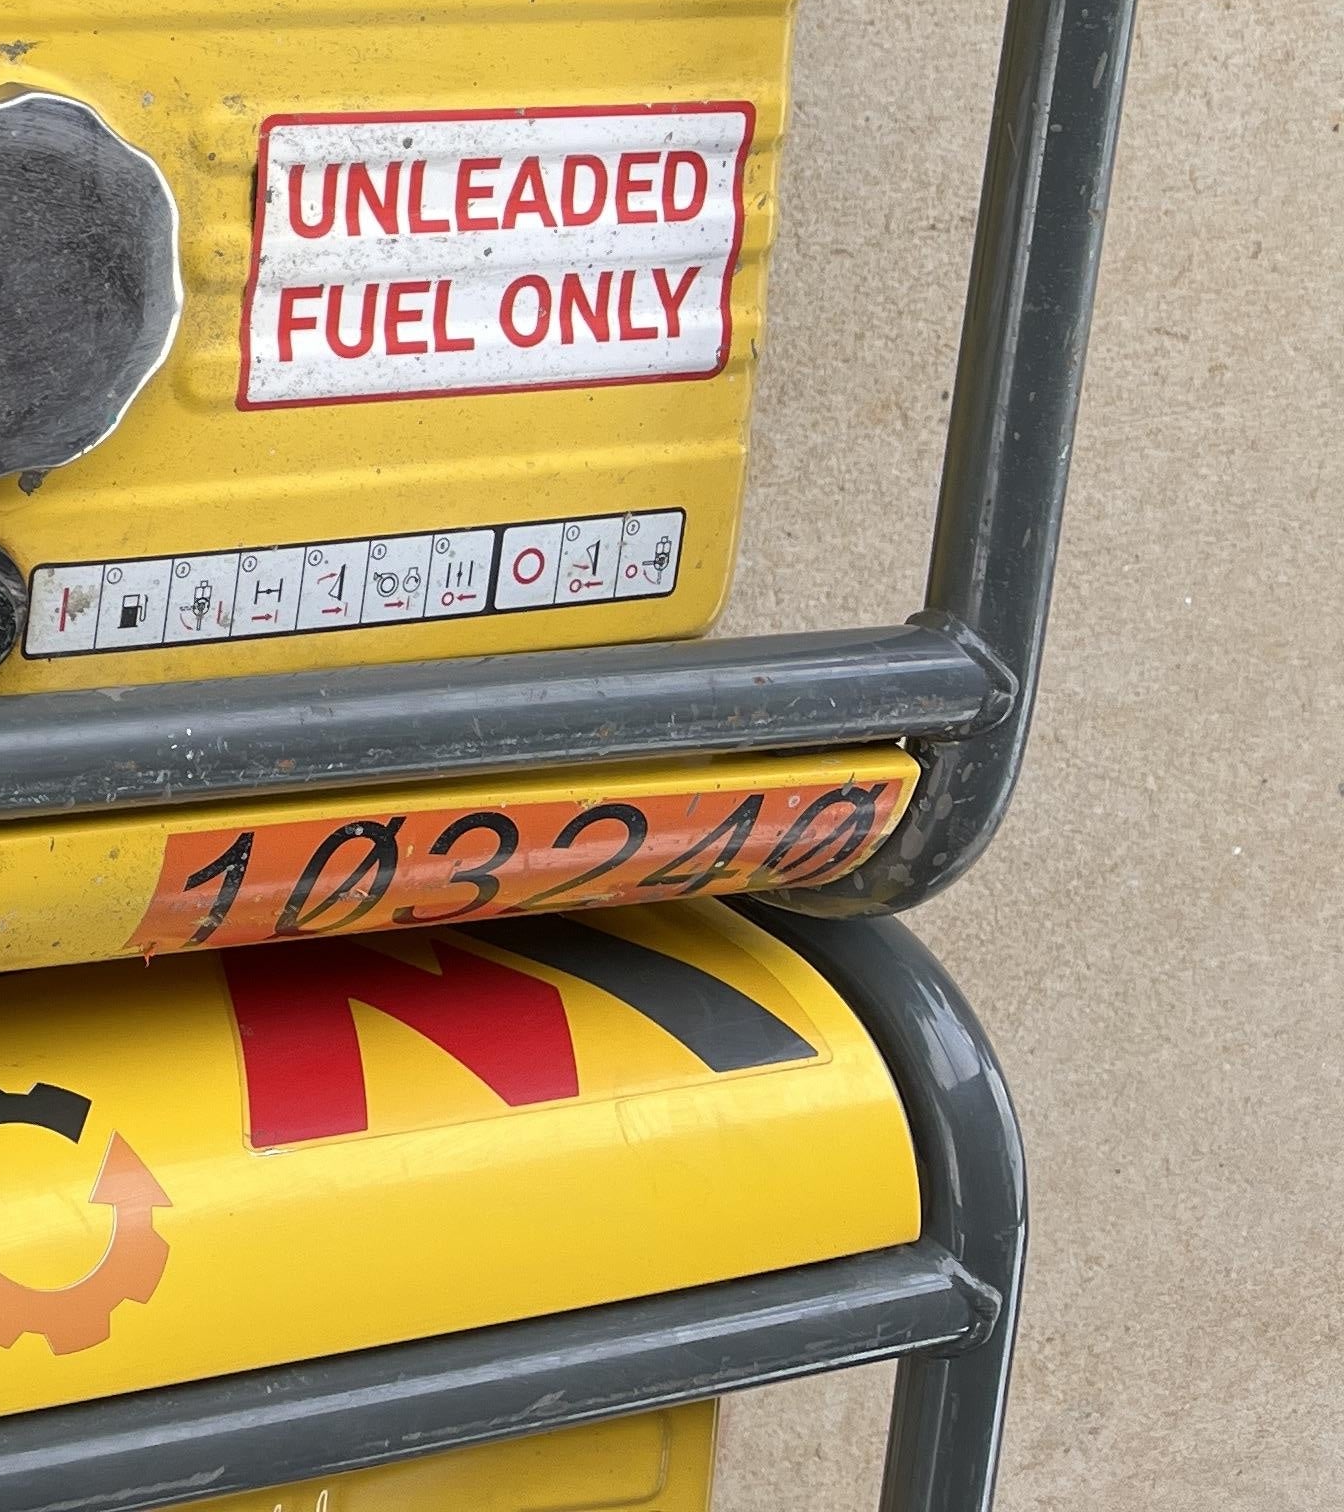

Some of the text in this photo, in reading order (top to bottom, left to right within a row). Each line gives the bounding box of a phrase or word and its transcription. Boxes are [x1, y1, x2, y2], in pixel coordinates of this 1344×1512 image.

[288, 150, 708, 239] UNLEADED
[277, 266, 701, 363] FUEL ONLY
